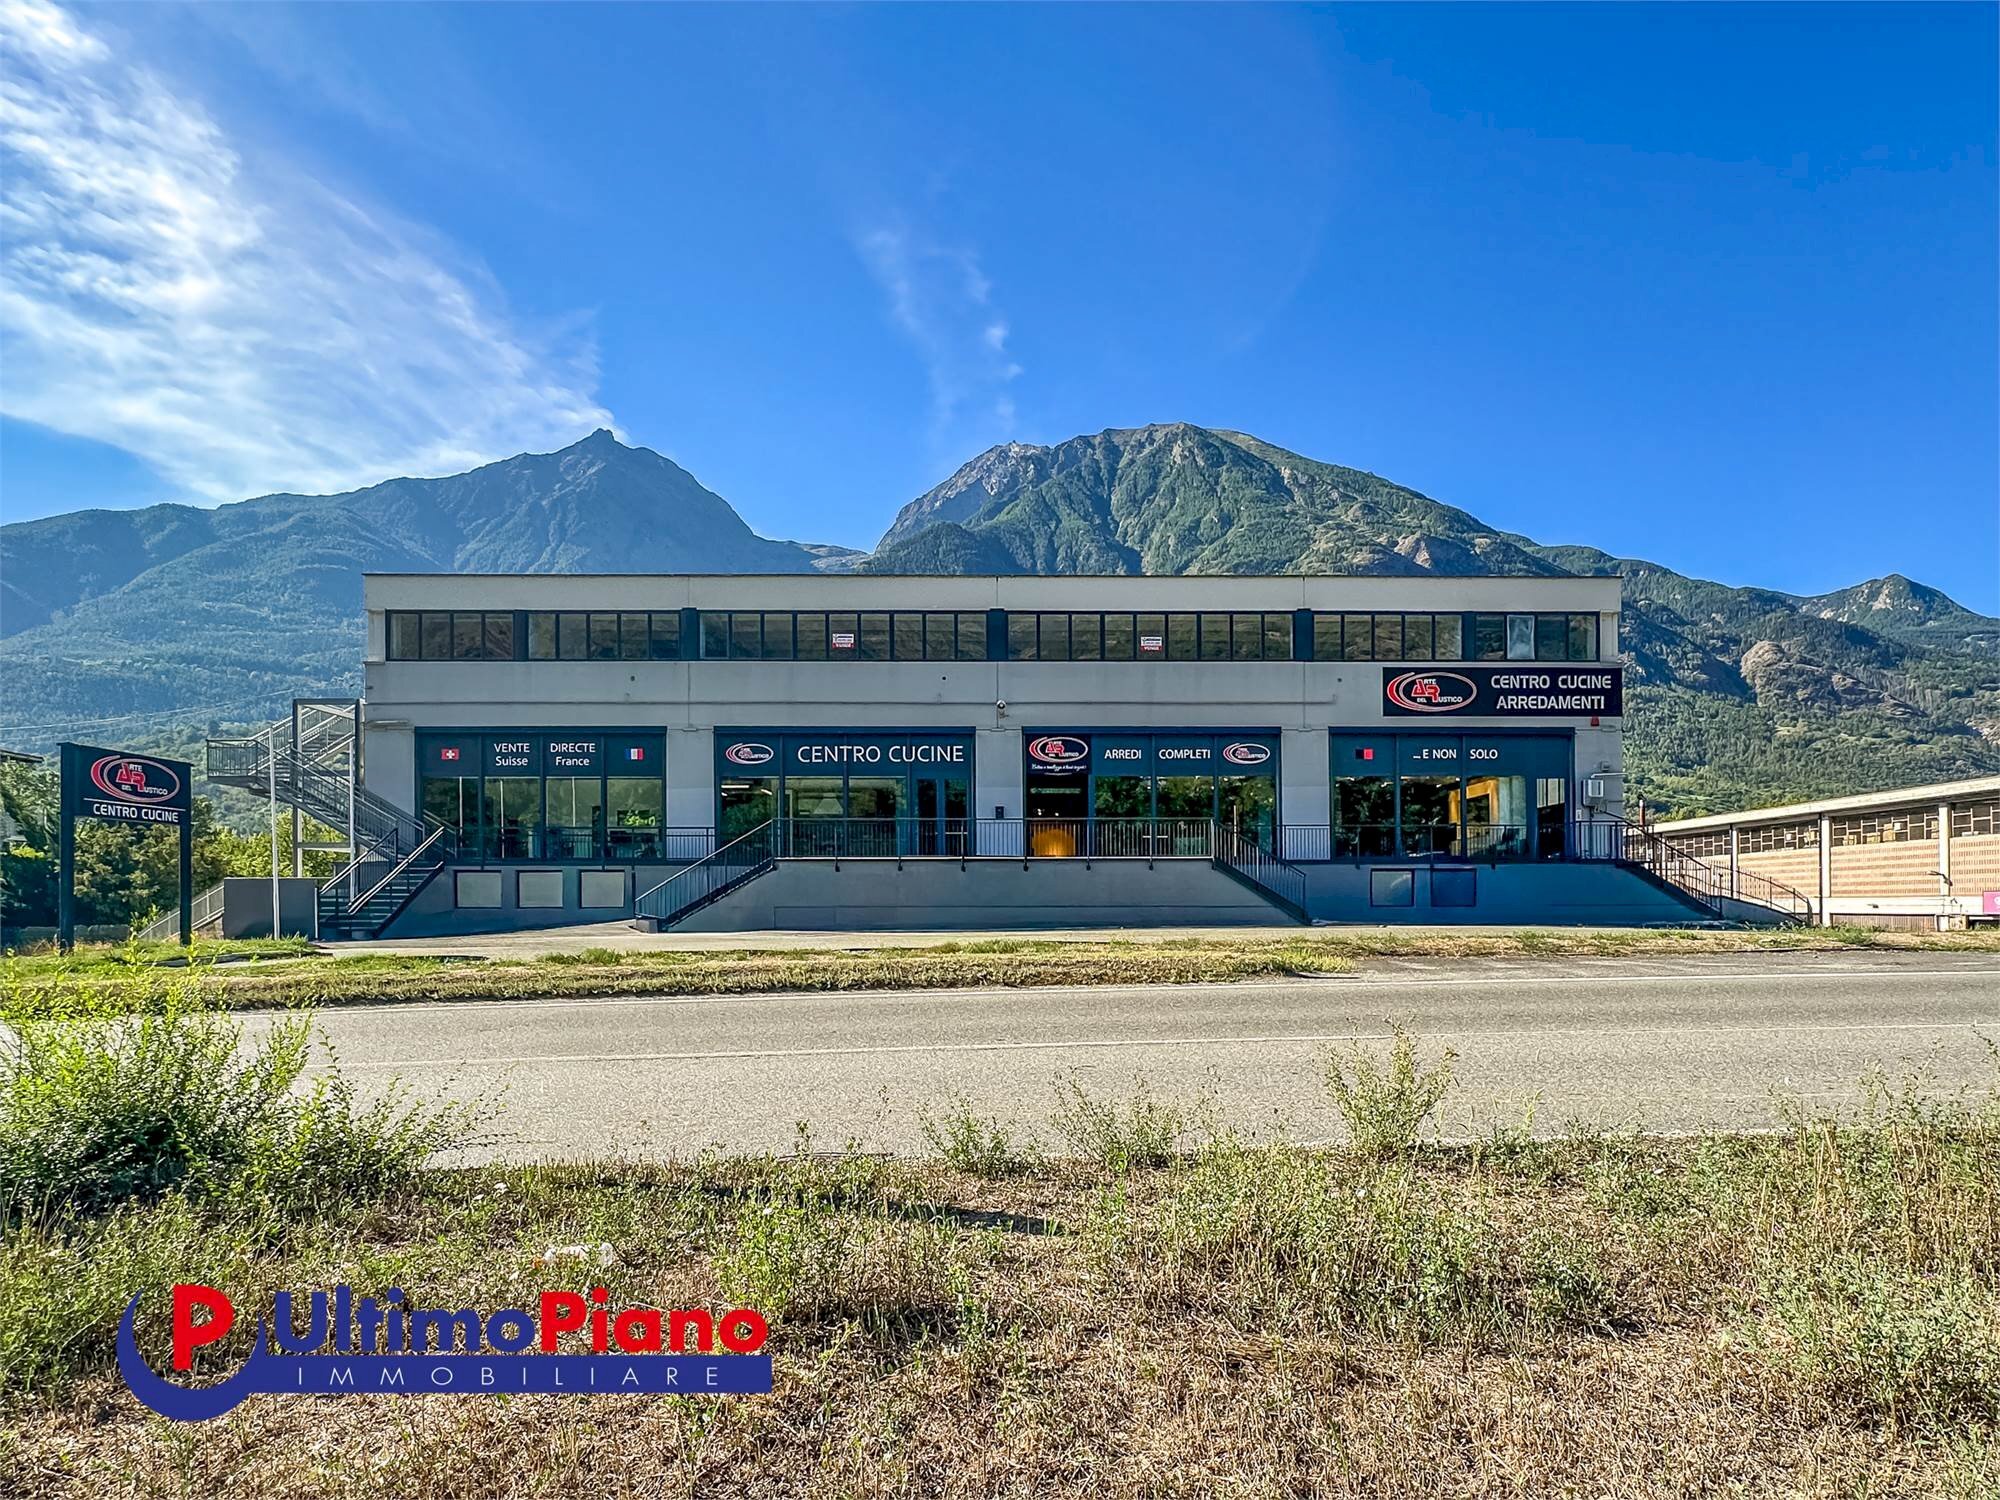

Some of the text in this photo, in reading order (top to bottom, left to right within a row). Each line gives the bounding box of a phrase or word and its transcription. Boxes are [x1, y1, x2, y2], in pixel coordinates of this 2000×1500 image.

[1491, 675, 1612, 689] CENTRO CUCINE
[1496, 695, 1605, 709] ARREDAMENTI
[493, 743, 596, 753] VENTE DIRECTE
[797, 745, 965, 763] CENTRO CUCINE
[1432, 749, 1457, 759] NON
[1470, 749, 1498, 759] SOLO
[1104, 749, 1211, 760] ARREDI COMPLETI
[495, 756, 590, 766] Suisse France
[93, 803, 179, 823] CENTRO CUCINE
